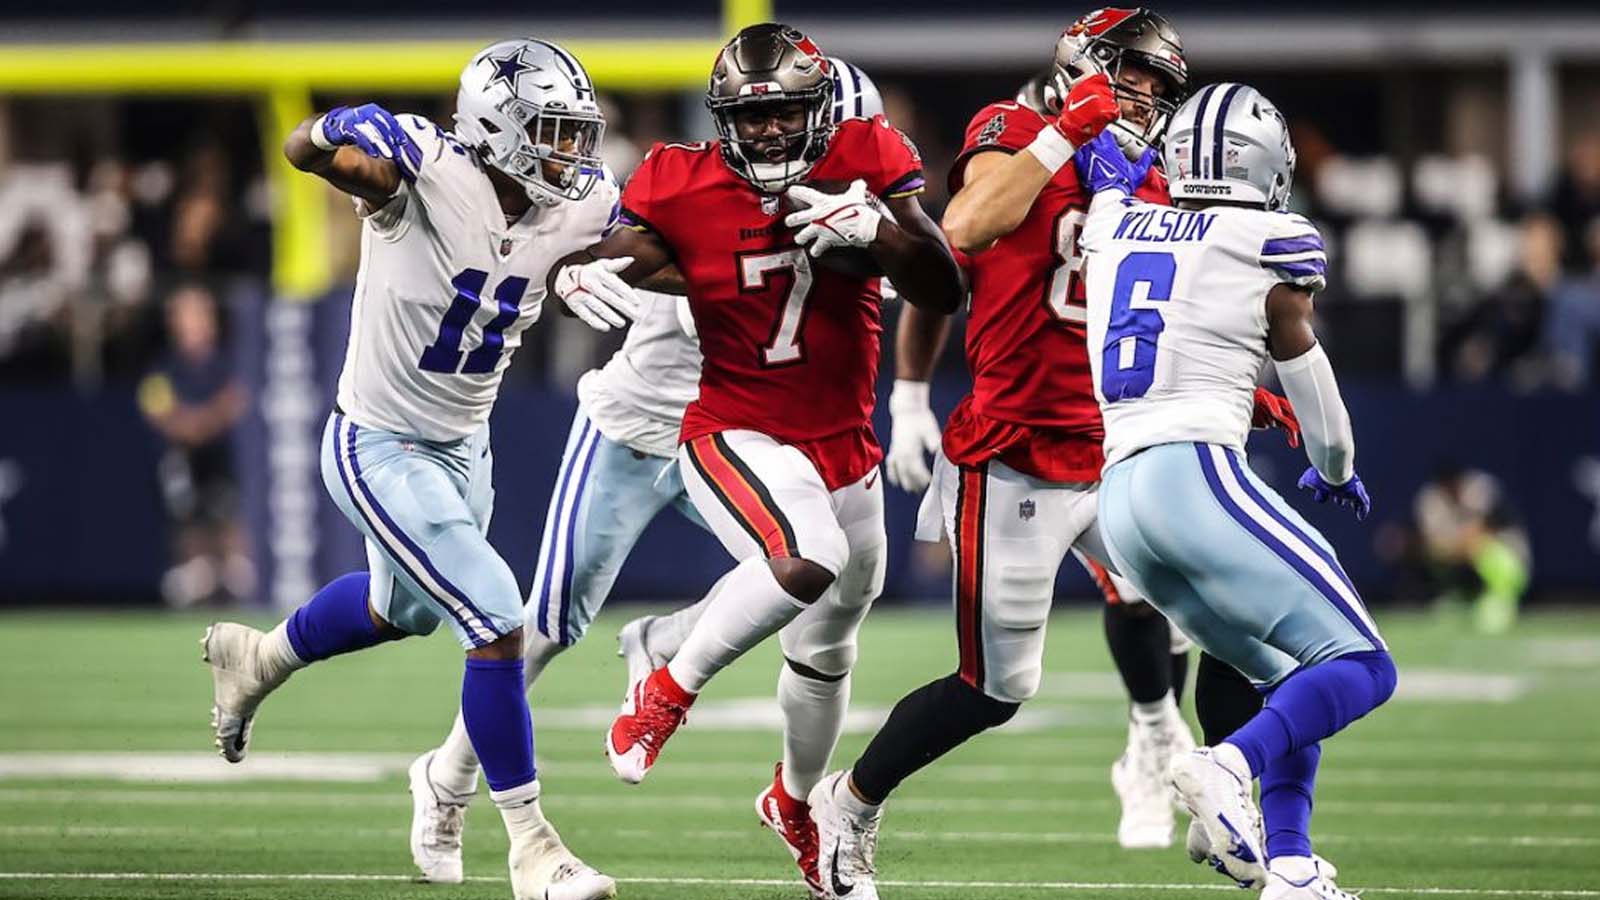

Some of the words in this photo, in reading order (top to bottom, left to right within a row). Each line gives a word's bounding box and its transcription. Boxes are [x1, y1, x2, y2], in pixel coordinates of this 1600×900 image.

[1112, 209, 1219, 242] WILSON
[1183, 184, 1232, 195] COWBOYS
[418, 267, 530, 374] 11
[736, 249, 813, 366] 7
[1101, 251, 1177, 403] 6
